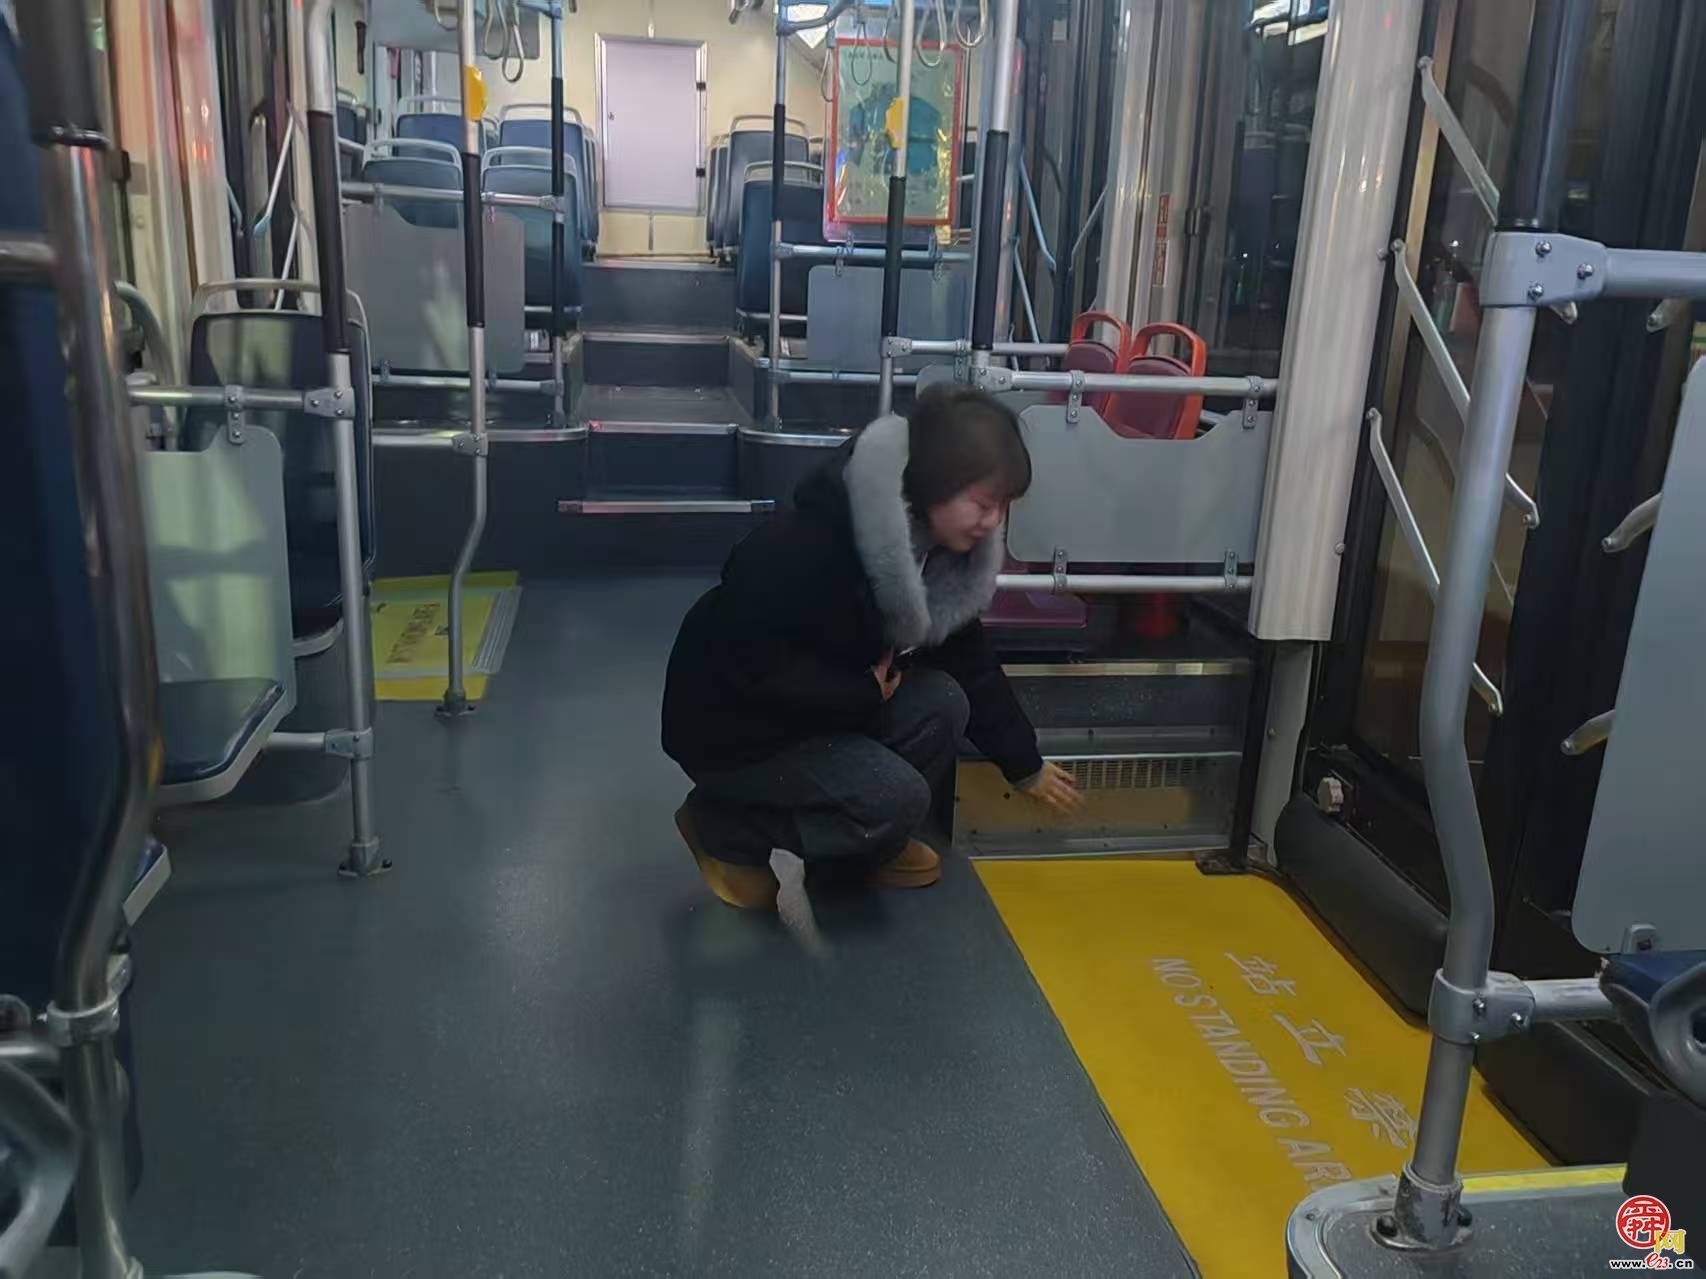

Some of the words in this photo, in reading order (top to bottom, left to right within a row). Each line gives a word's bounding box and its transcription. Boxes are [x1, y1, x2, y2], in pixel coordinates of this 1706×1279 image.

[1151, 957, 1201, 989] NO
[1173, 993, 1310, 1129] STANDING
[1277, 1137, 1352, 1190] AR
